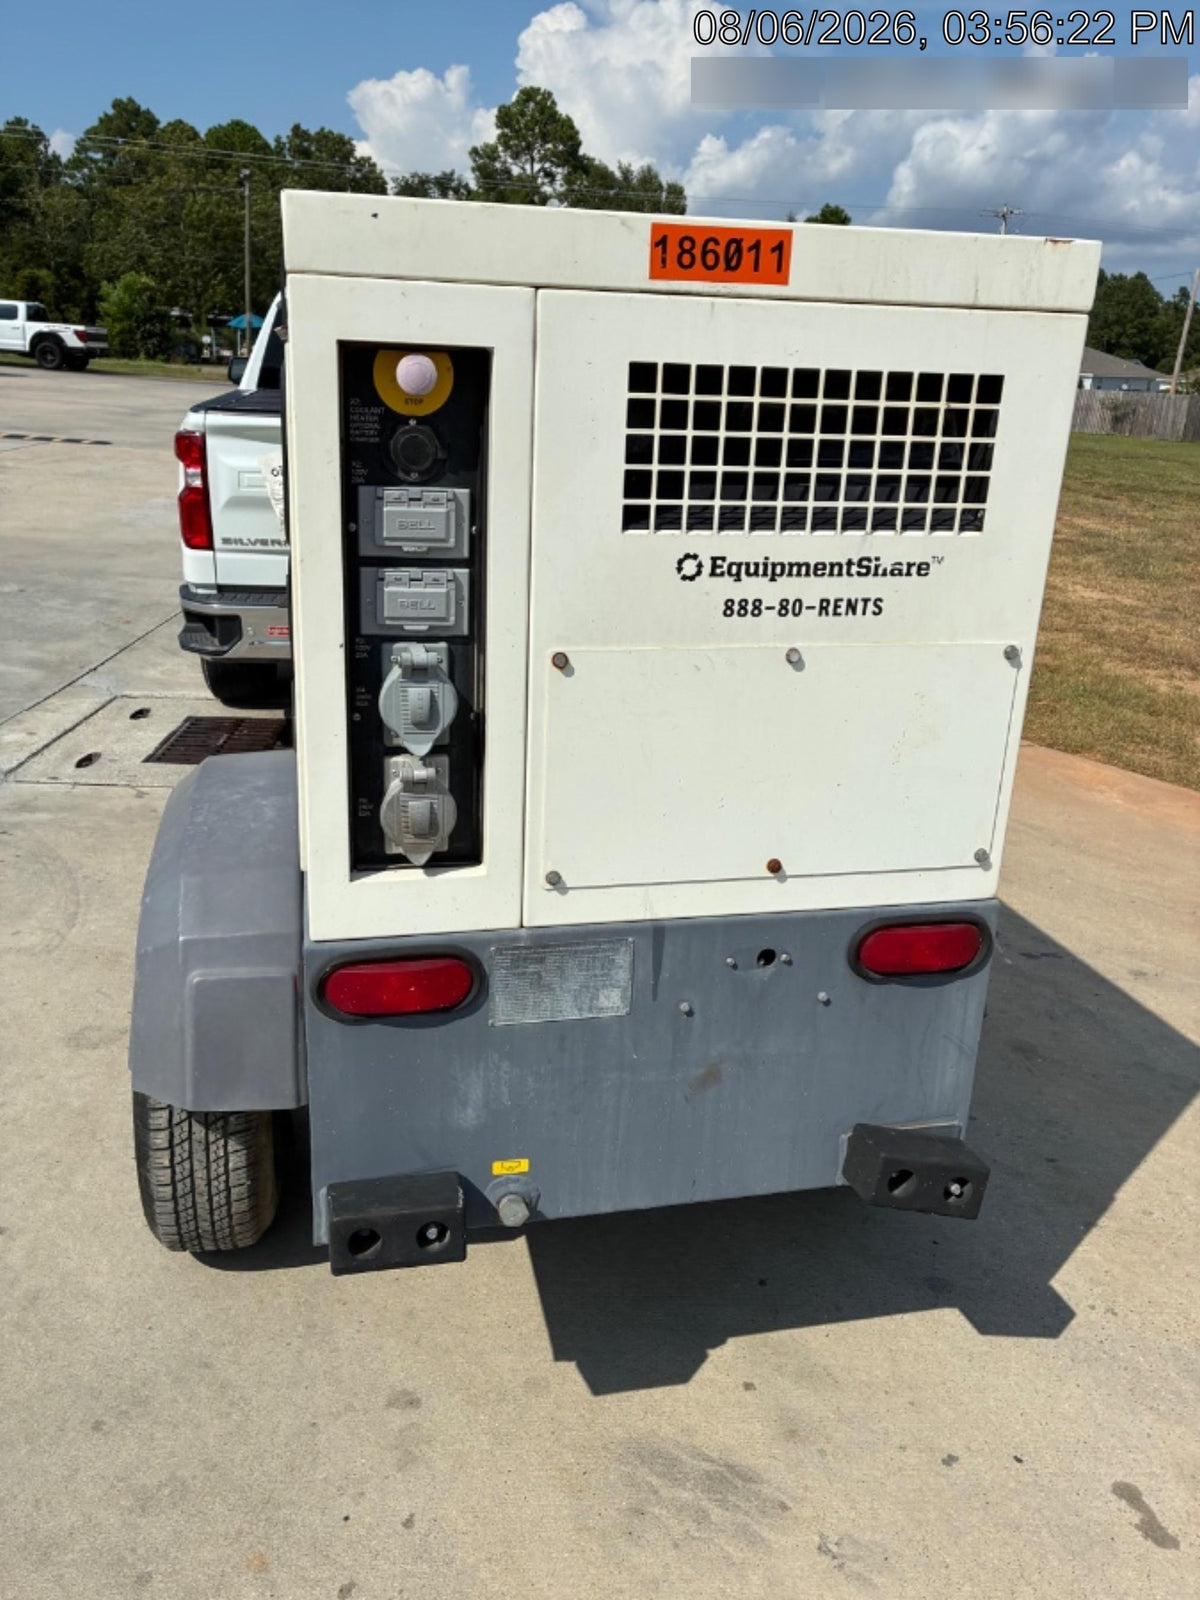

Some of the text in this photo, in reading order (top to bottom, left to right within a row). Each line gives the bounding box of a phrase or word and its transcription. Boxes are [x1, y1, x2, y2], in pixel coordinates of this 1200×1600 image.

[654, 234, 785, 274] 186011
[708, 556, 931, 582] EquipmentShare
[722, 597, 884, 618] 888-80-RENTS
